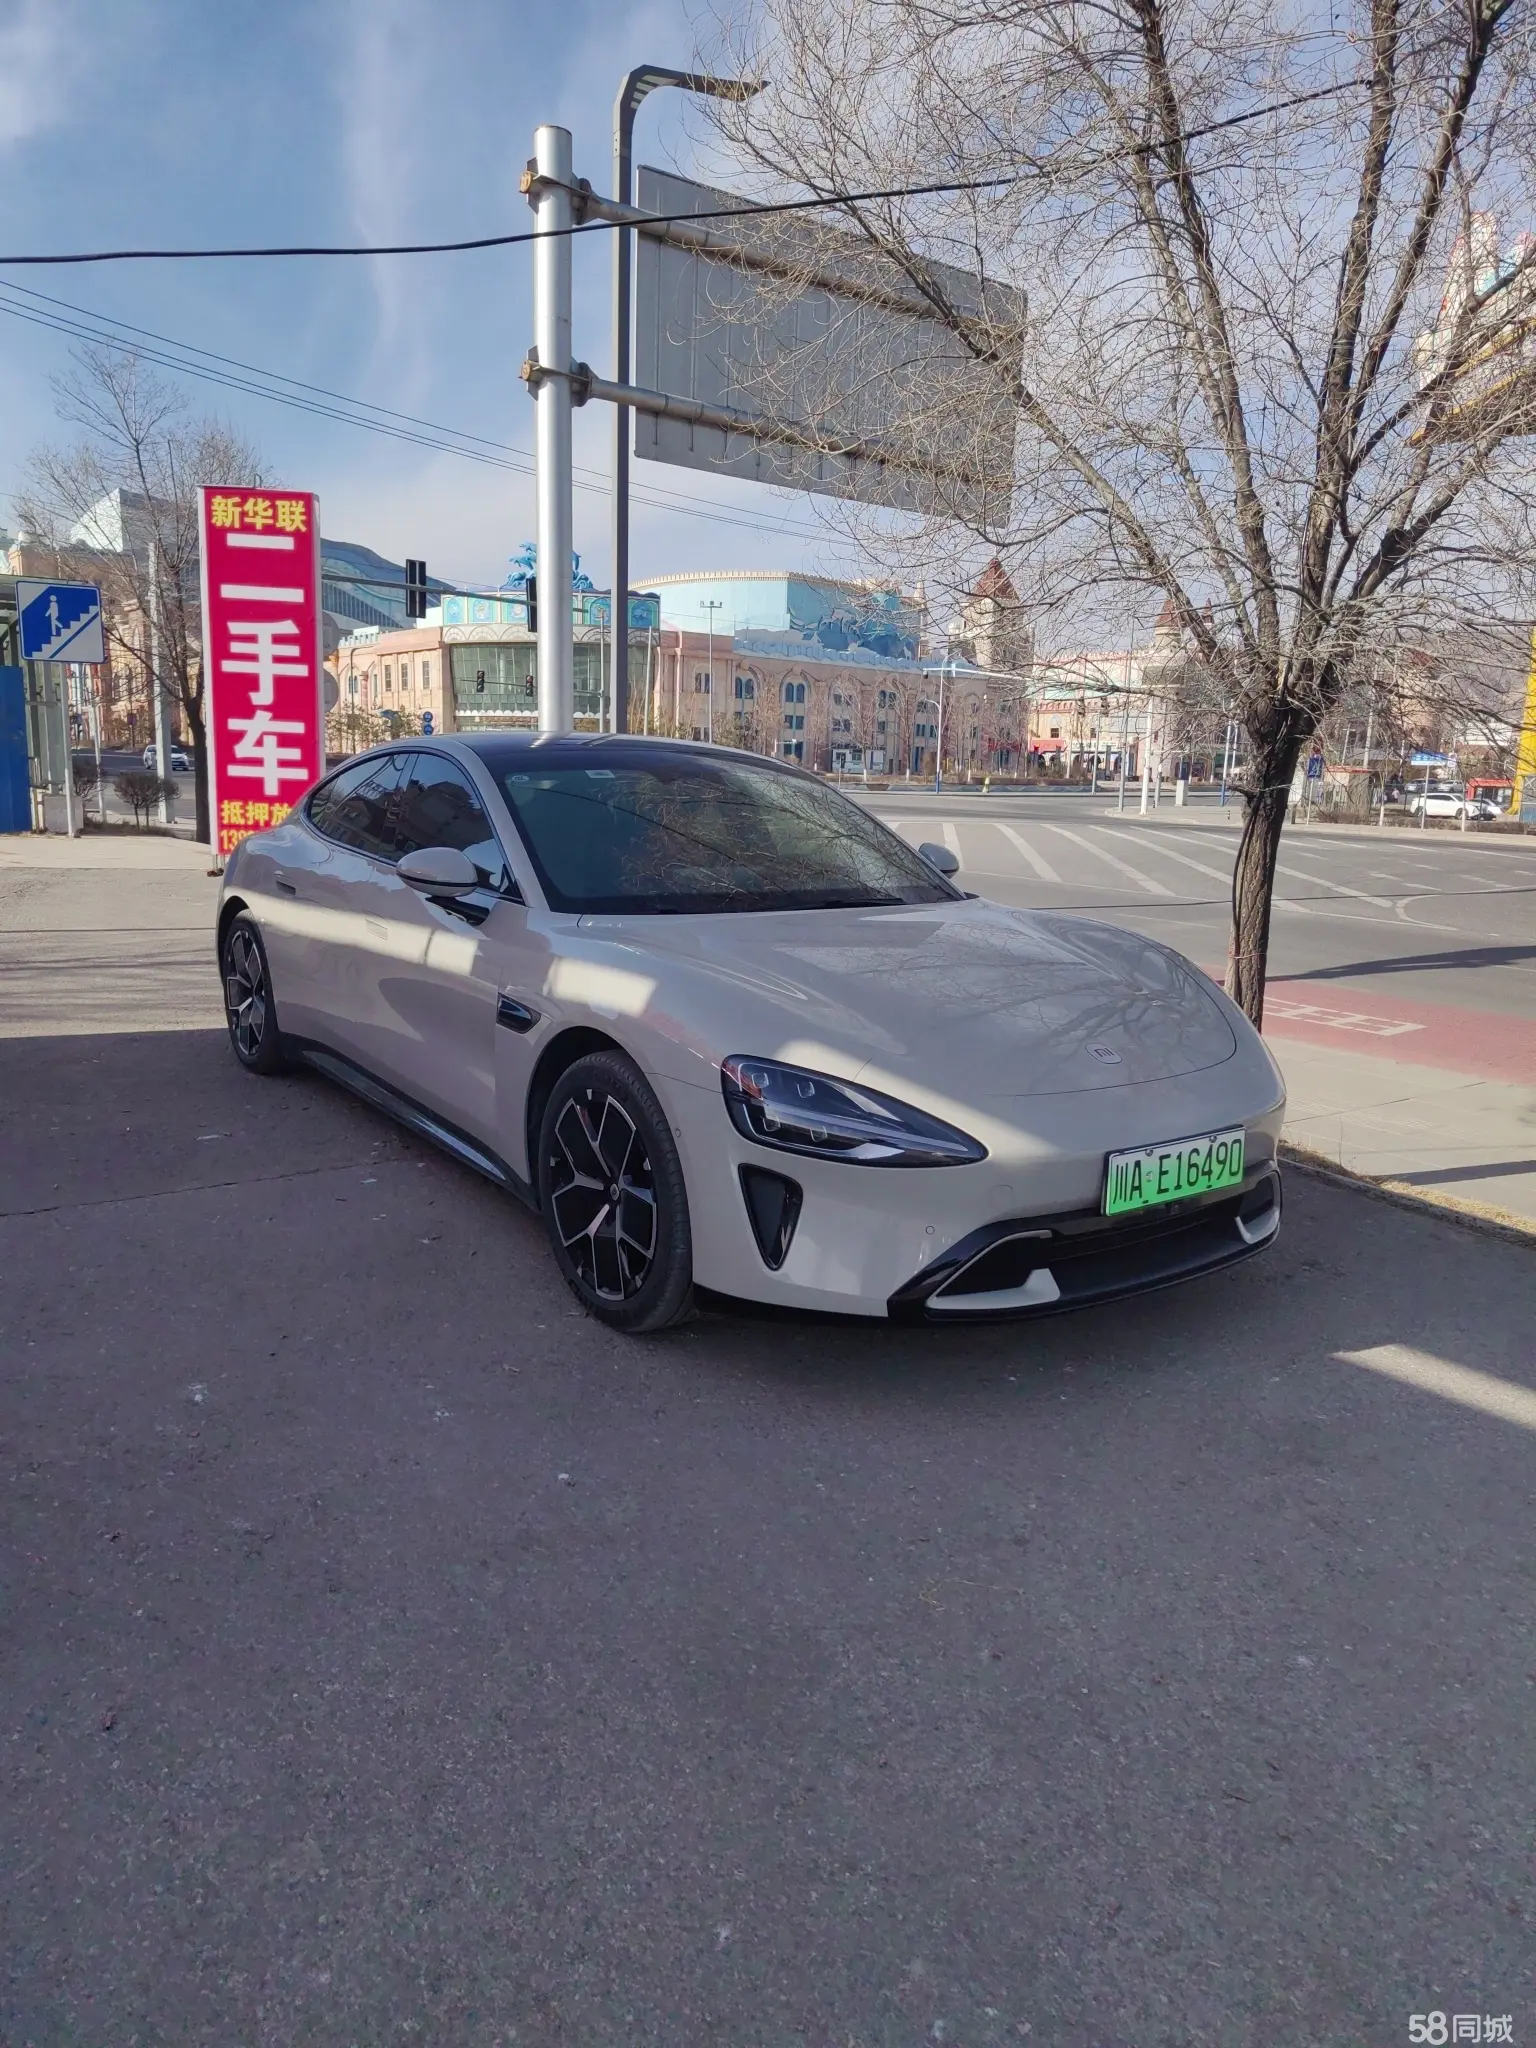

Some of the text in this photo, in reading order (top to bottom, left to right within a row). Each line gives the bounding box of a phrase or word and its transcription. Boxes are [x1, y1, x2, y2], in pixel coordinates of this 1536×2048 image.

[211, 495, 307, 532] 新华联
[220, 533, 309, 796] 二手车
